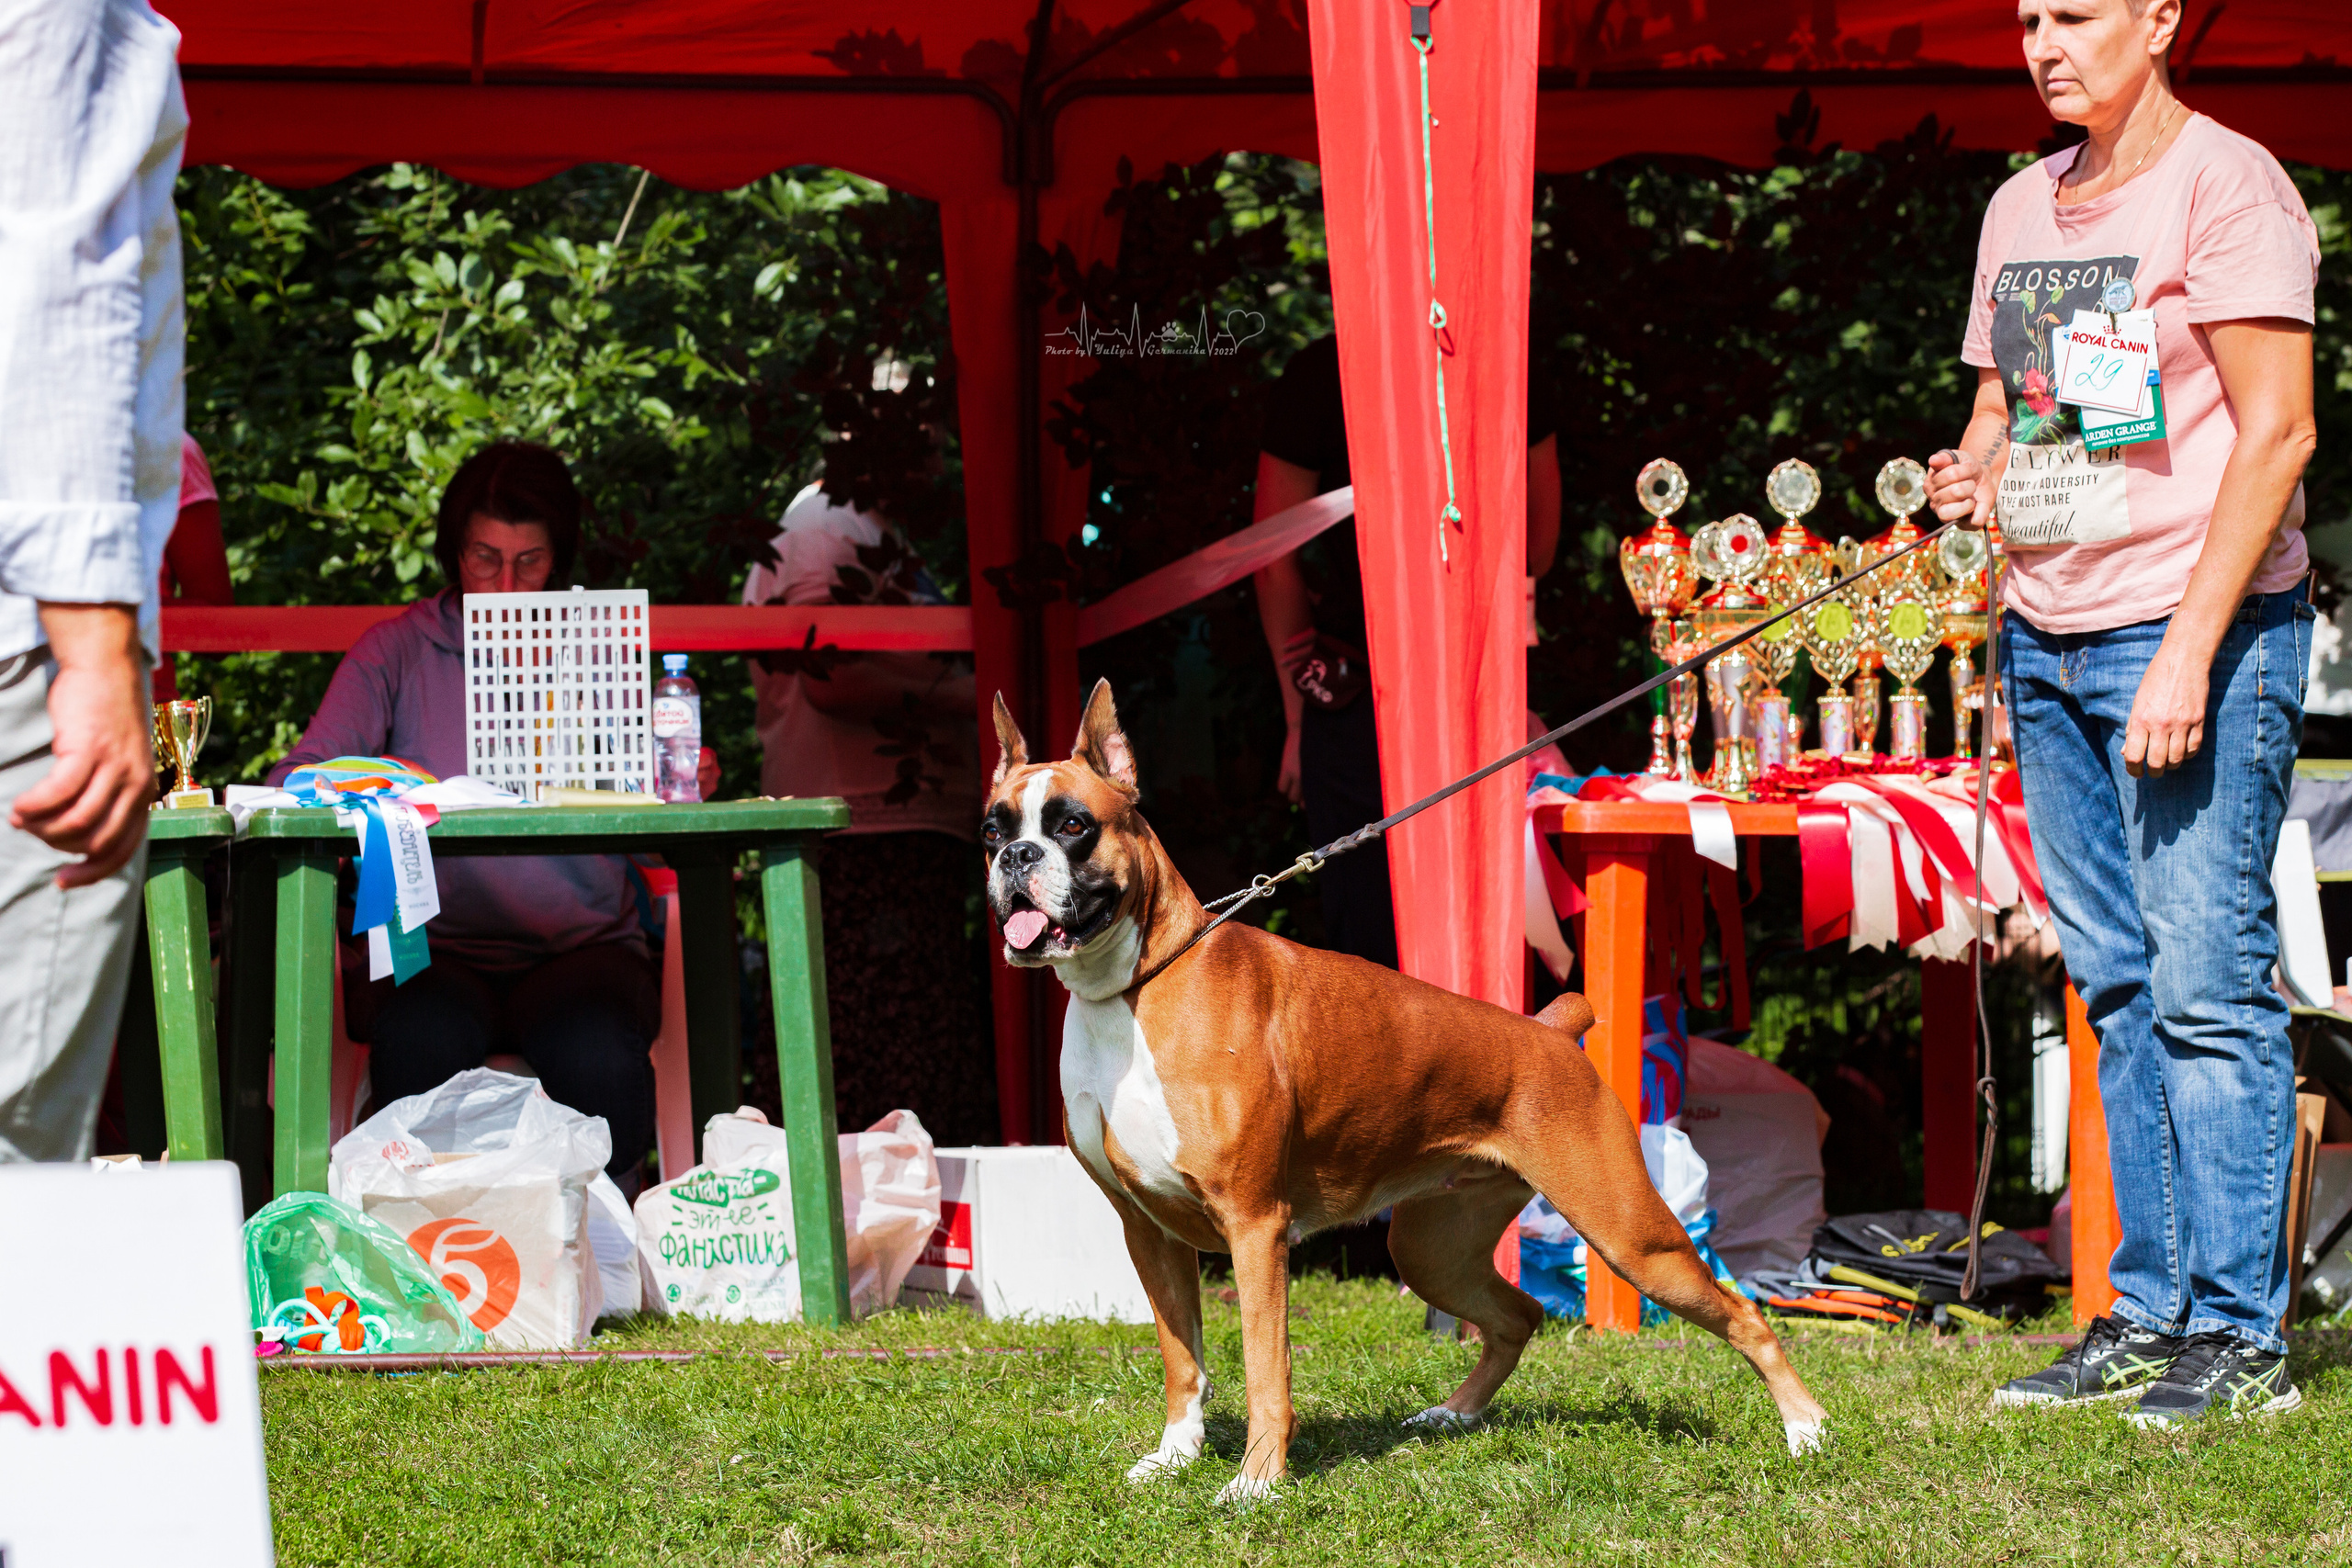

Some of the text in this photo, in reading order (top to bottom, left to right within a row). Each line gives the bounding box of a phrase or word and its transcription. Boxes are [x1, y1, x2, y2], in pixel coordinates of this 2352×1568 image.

[2072, 332, 2107, 348] ROYAL
[2110, 338, 2149, 355] CANIN
[2075, 353, 2124, 391] 29
[2085, 421, 2157, 443] ARDEN GRANGE
[2001, 479, 2030, 492] OOMS
[2040, 473, 2099, 490] ADVERSITY
[2018, 495, 2041, 508] MOST
[2044, 492, 2071, 506] RARE
[2008, 511, 2075, 547] beautiful.
